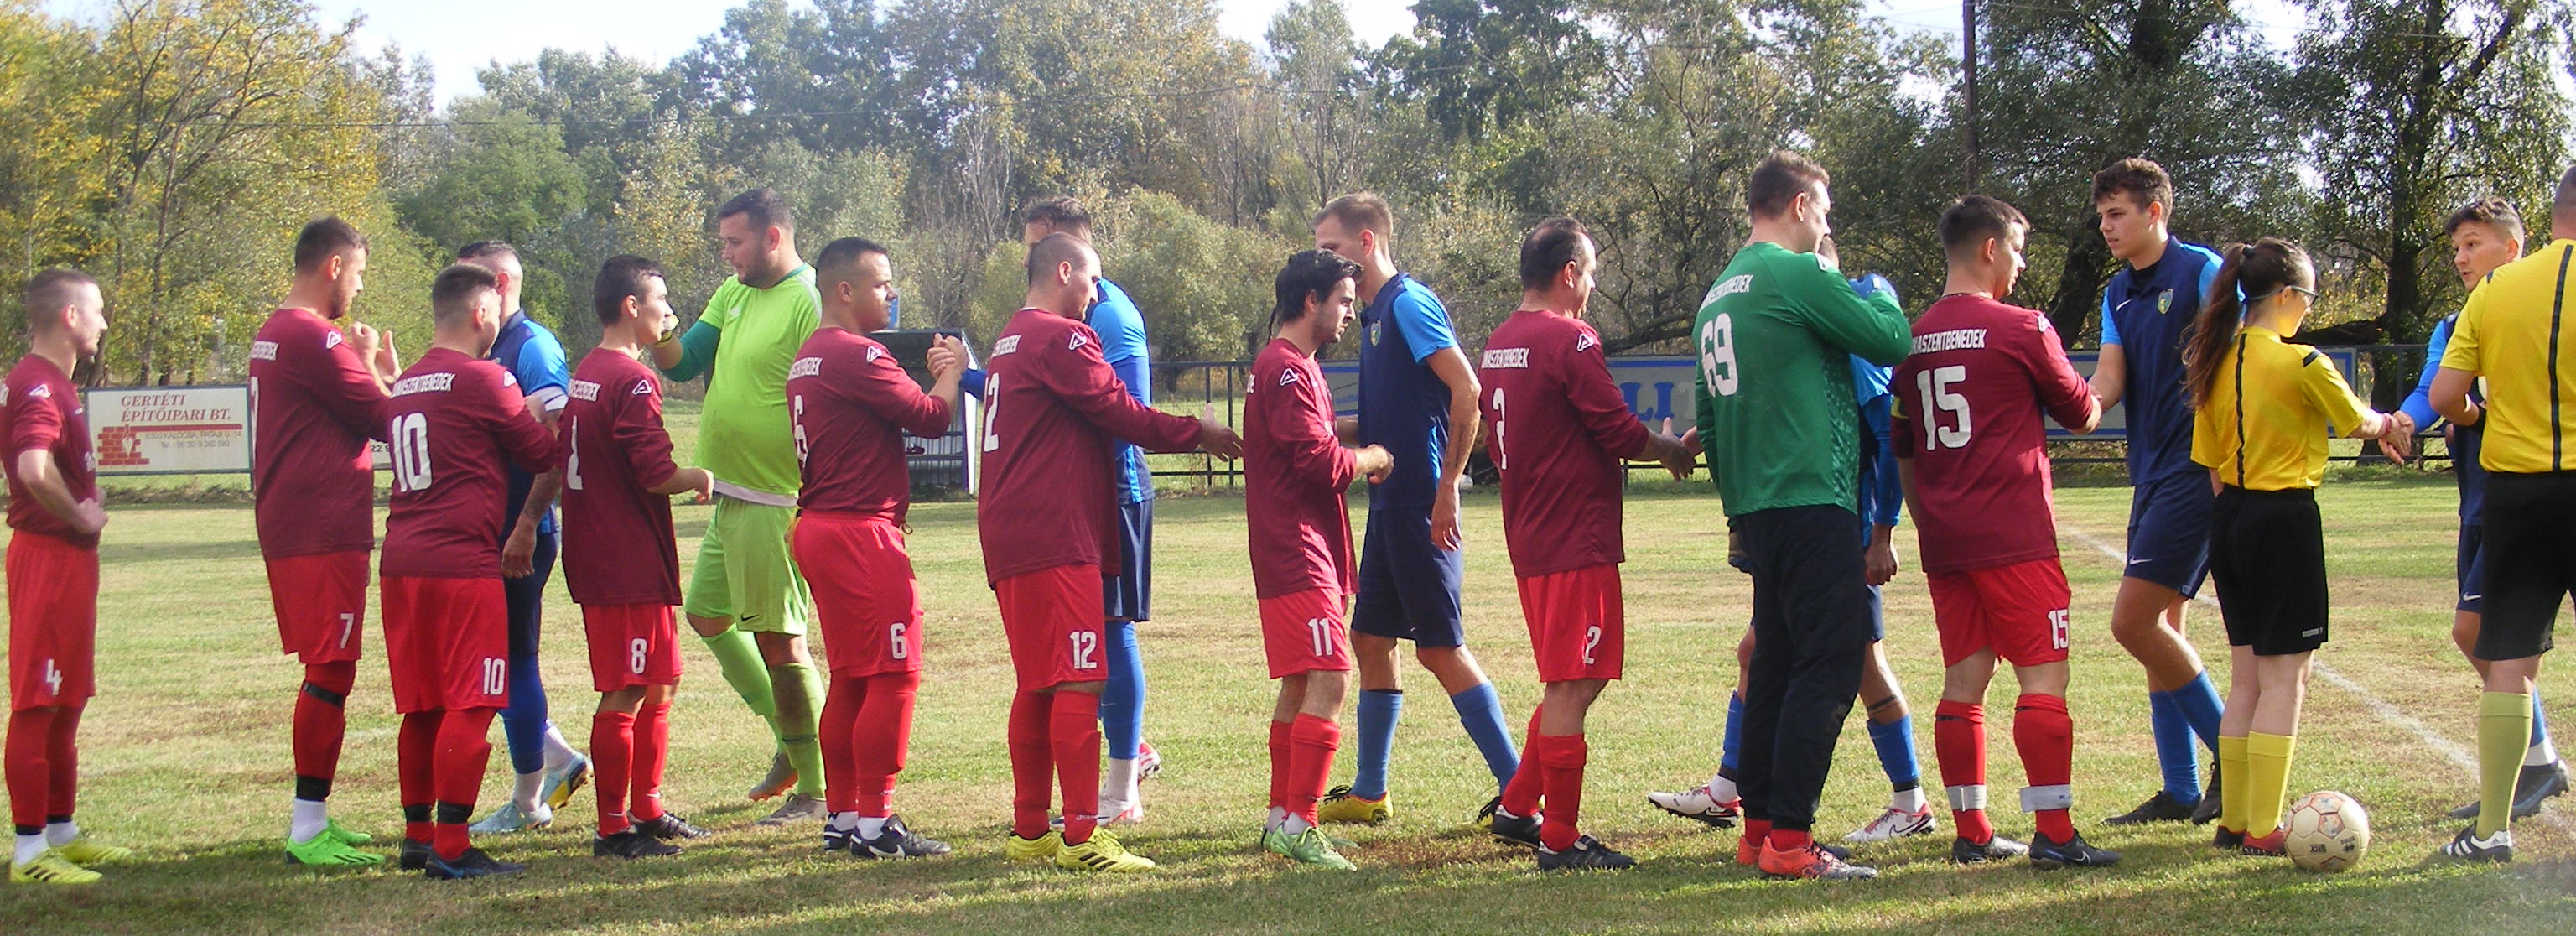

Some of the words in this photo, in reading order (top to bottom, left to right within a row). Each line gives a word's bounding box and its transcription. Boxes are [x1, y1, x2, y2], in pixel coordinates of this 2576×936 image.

[1701, 313, 1739, 398] 69
[121, 393, 186, 408] GERTÉTI
[121, 407, 205, 423] ÉPÍTŐIPARI
[209, 408, 231, 420] BT.
[1918, 365, 1972, 451] 15
[392, 413, 432, 492] 10
[340, 613, 354, 648] 7
[890, 622, 908, 659] 6
[1308, 617, 1332, 657] 11
[1583, 626, 1602, 665] 2
[2048, 610, 2069, 650] 15
[631, 638, 647, 674] 8
[1070, 631, 1098, 669] 12
[46, 658, 63, 695] 4
[483, 658, 506, 695] 10
